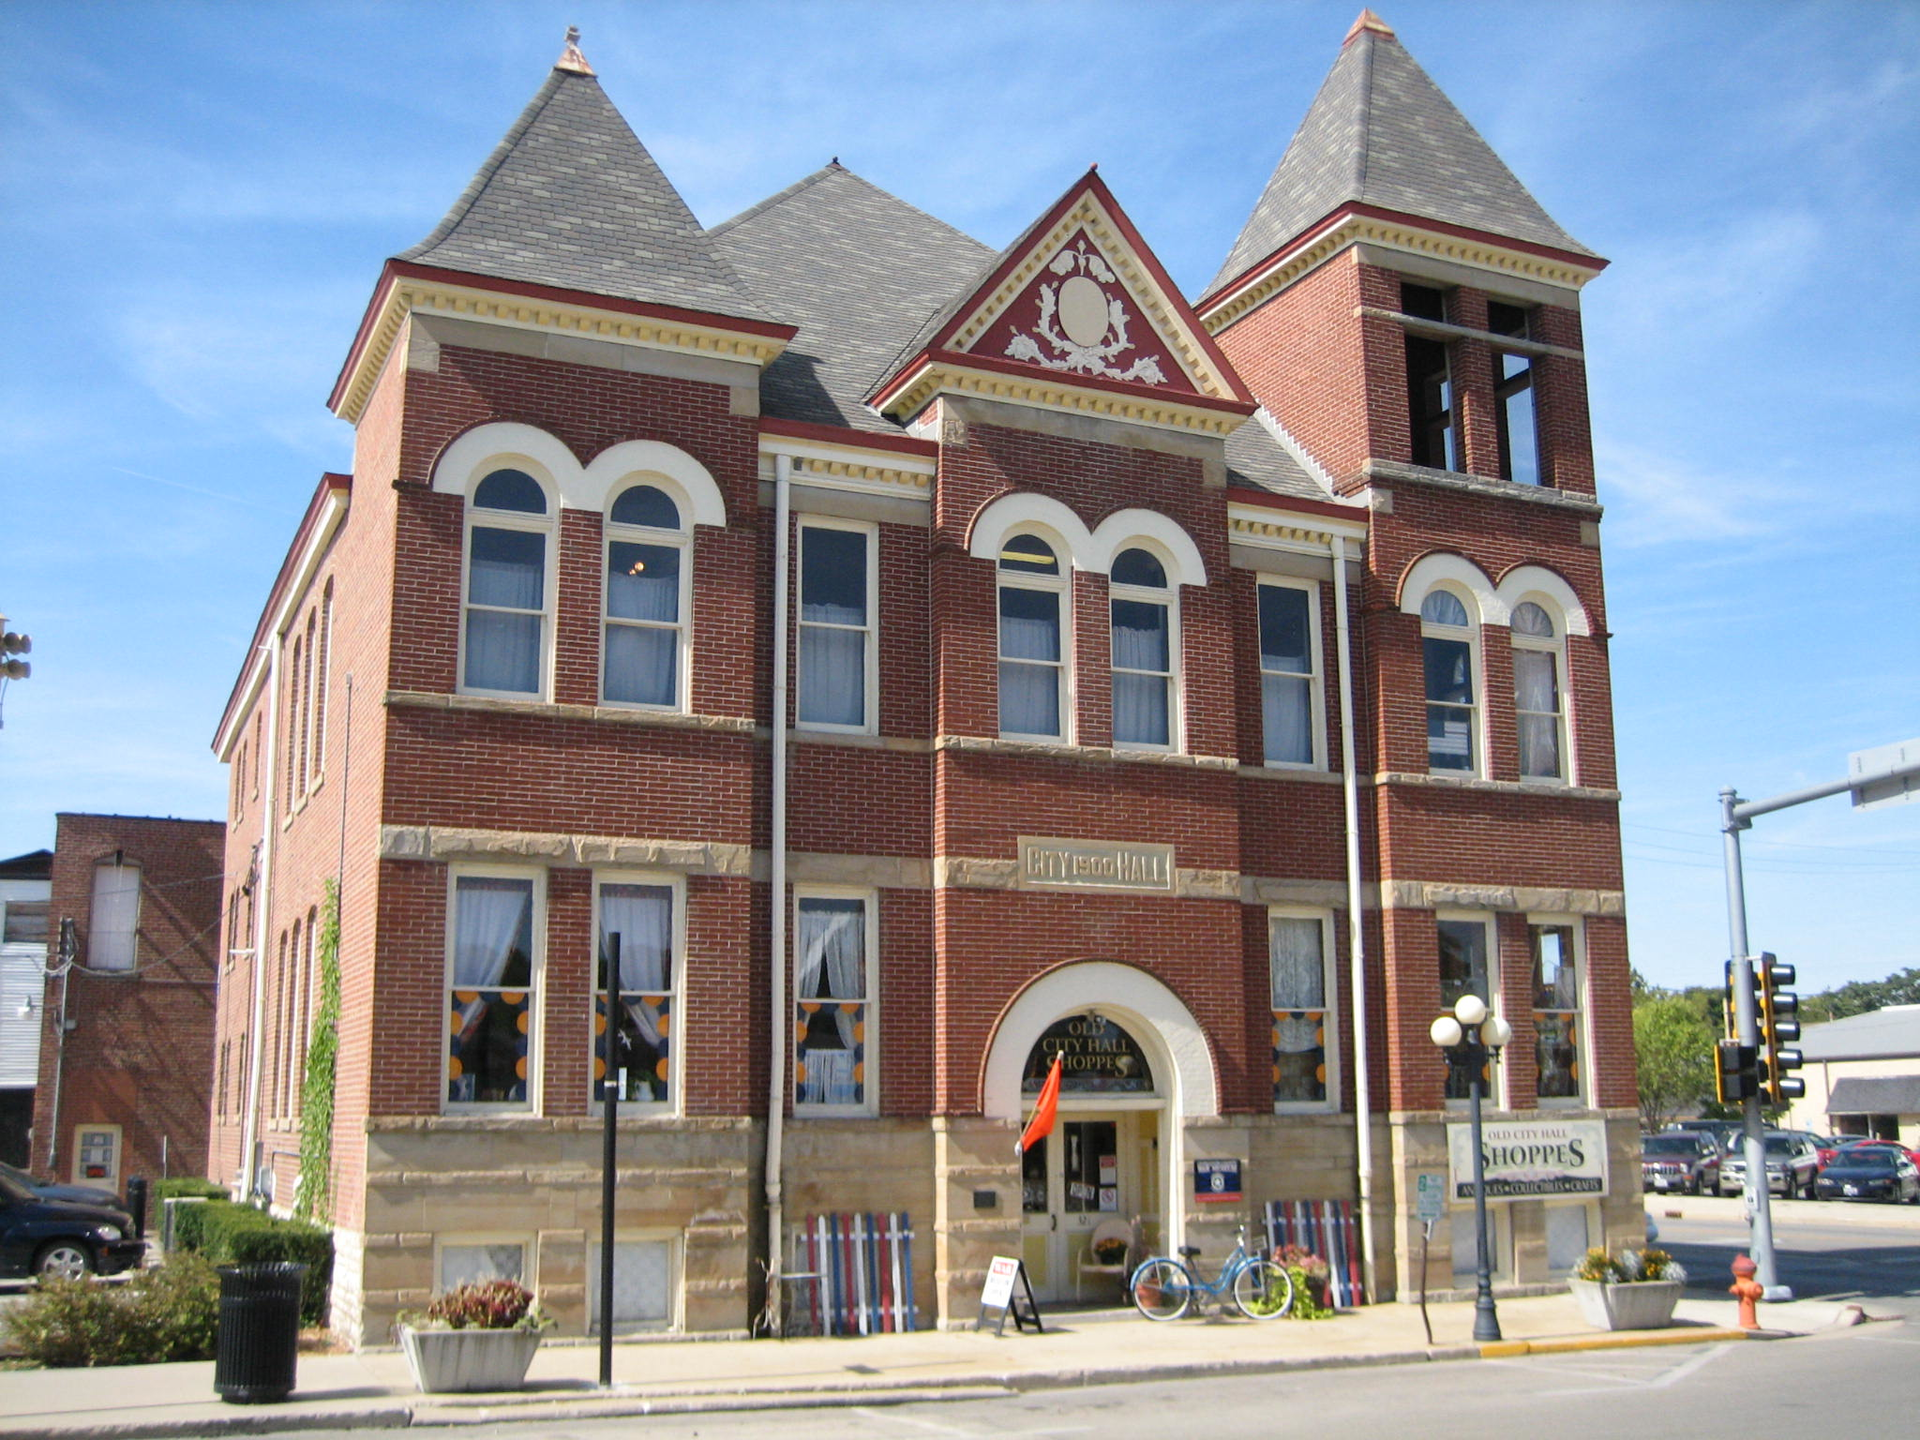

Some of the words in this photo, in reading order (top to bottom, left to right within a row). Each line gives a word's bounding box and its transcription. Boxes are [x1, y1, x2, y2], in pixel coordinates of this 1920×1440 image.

[1027, 847, 1070, 878] CITY
[1073, 855, 1114, 876] 1900
[1117, 851, 1168, 882] HALL
[1068, 1020, 1105, 1036] OLD
[1042, 1037, 1083, 1053] CITY
[1087, 1039, 1131, 1053] HALL
[1488, 1130, 1512, 1141] OLD
[1514, 1129, 1538, 1141] CITY
[1541, 1128, 1568, 1140] HALL
[1461, 1183, 1504, 1197] ANUES
